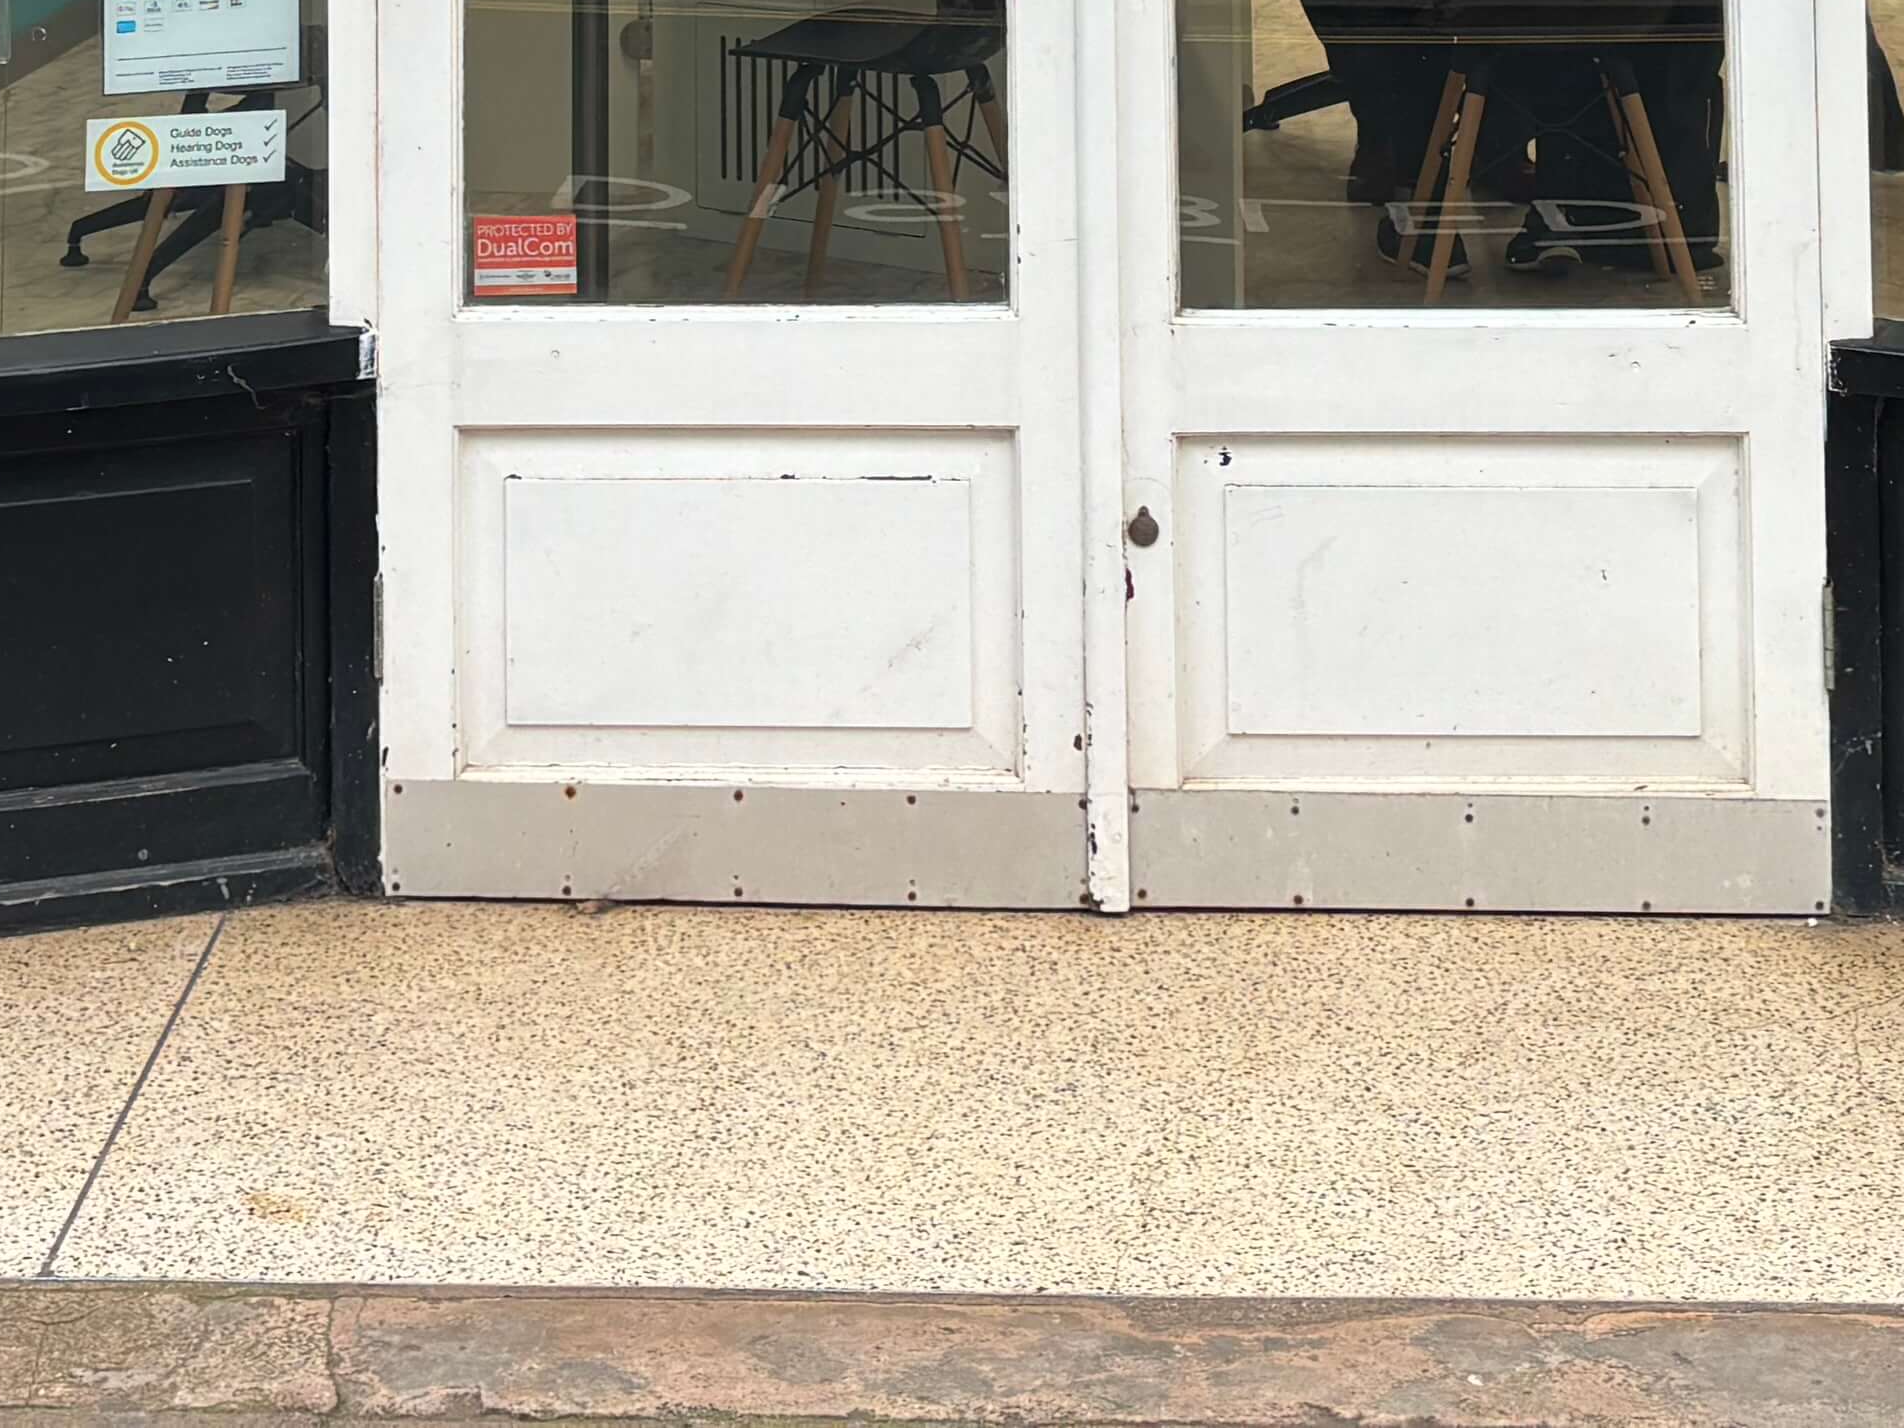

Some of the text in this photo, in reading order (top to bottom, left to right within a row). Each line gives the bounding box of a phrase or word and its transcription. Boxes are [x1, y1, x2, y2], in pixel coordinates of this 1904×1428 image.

[170, 126, 233, 139] Guide Dogs
[170, 140, 243, 154] Hearing Dogs
[170, 154, 259, 168] Assistance Dogs
[478, 223, 573, 237] PROTECTED BY
[477, 237, 574, 257] DualCom
